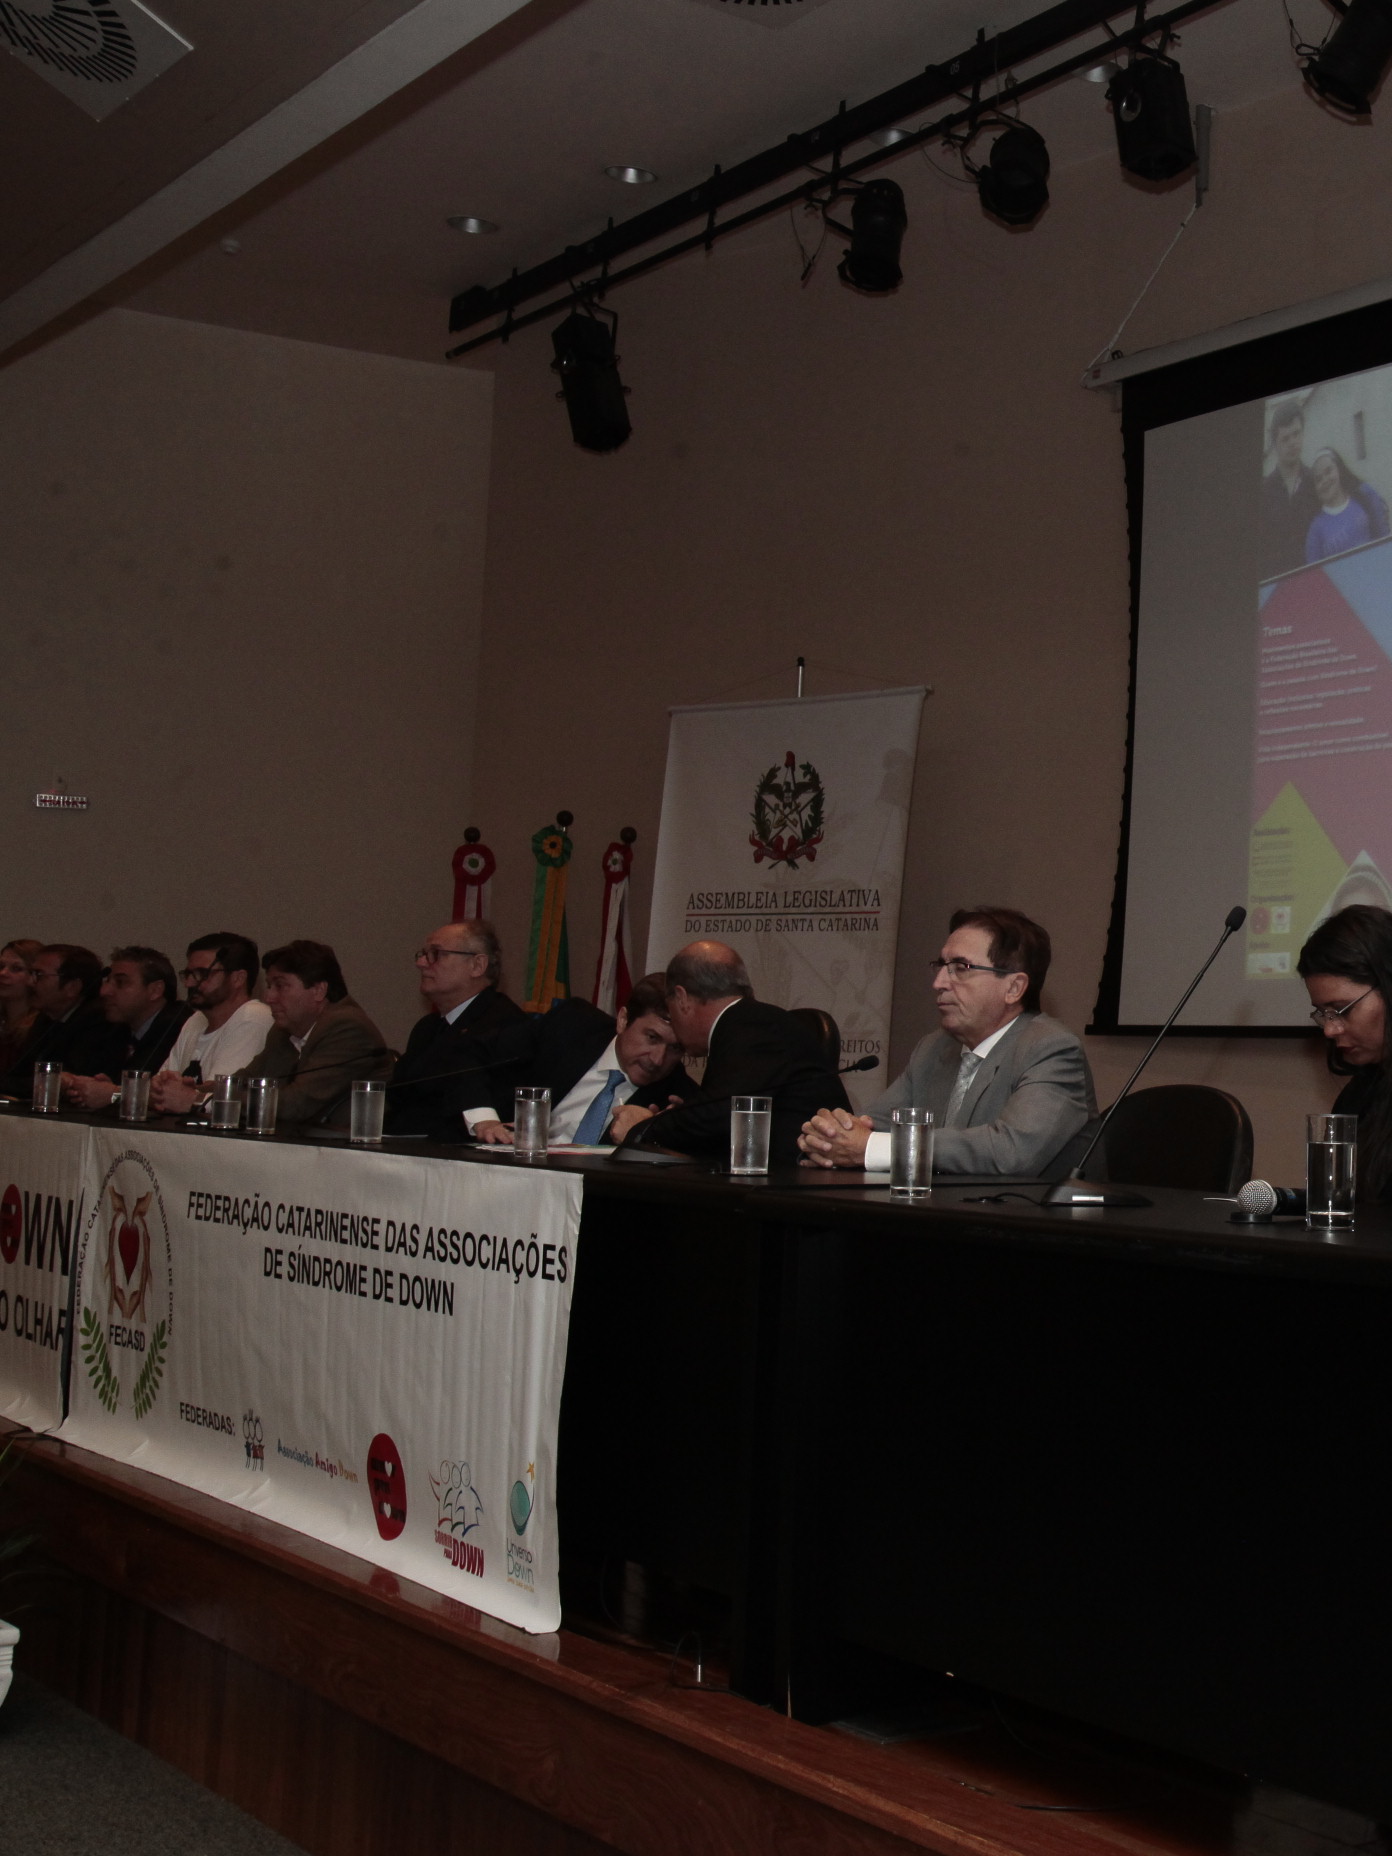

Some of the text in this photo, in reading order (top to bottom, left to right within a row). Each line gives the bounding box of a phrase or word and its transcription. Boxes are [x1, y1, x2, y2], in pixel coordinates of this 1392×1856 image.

[687, 889, 882, 910] ASSEMBLEIA LEGISLATIVA
[685, 917, 880, 934] DO ESTADO DE SANTA CATARINA
[187, 1190, 568, 1285] FEDERAÇÃO CATARINENSE DAS ASSOCIAÇÕES
[263, 1244, 455, 1317] DE SÍNDROME DE DOWN
[109, 1323, 146, 1353] FECASD
[180, 1401, 236, 1437] FEDERADAS:
[315, 1452, 338, 1479] Amigo
[337, 1459, 359, 1484] Down
[451, 1538, 485, 1578] DOWN
[506, 1537, 533, 1564] Universo
